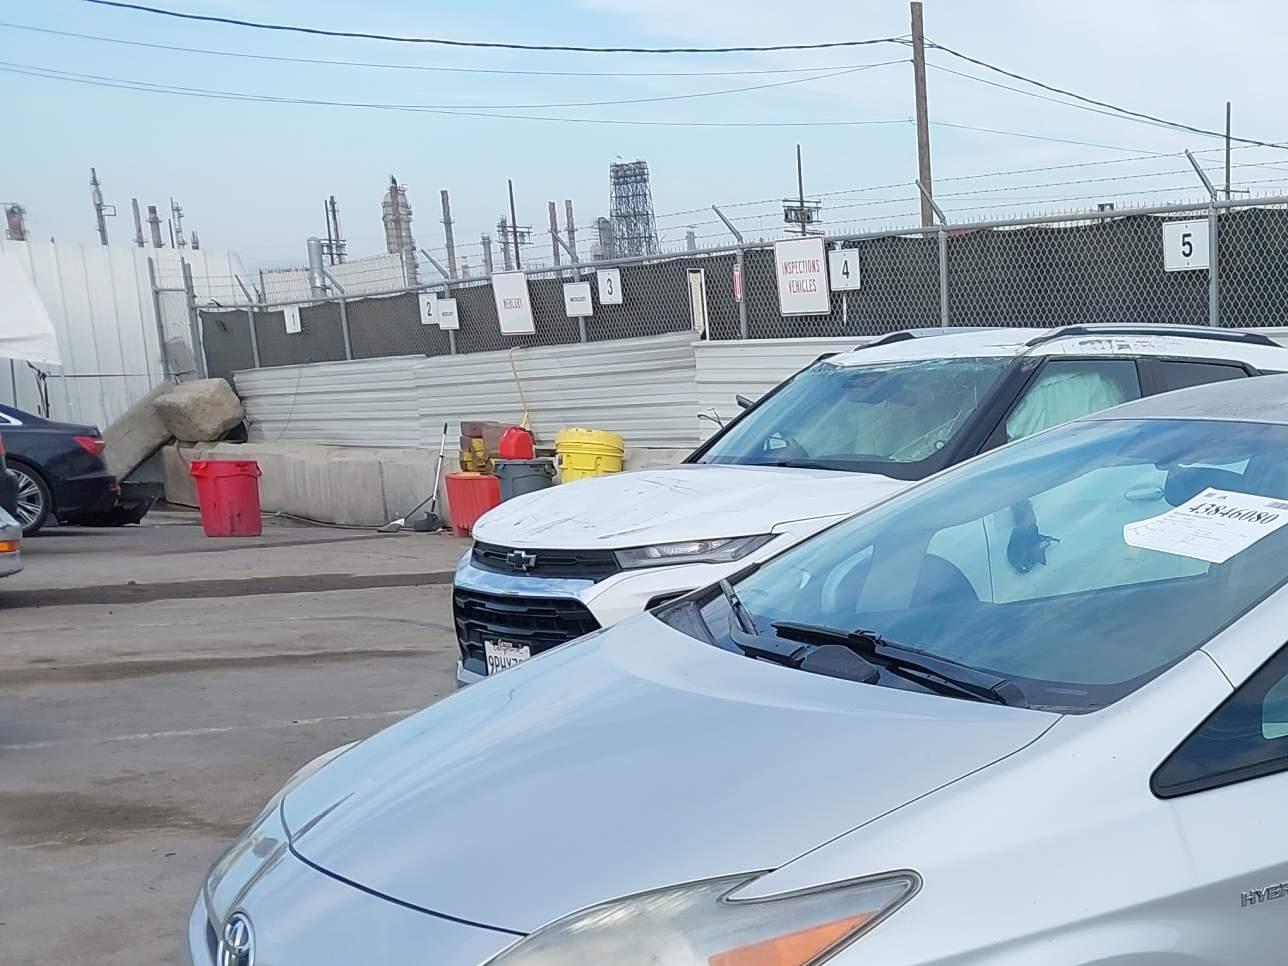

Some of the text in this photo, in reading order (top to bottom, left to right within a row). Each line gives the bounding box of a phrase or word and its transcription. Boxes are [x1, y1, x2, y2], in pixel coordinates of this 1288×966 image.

[1182, 233, 1193, 257] 5
[781, 259, 820, 276] INSPECTIONS
[842, 260, 850, 279] 4
[606, 278, 614, 296] 3
[788, 278, 817, 294] VEHICLES
[426, 301, 433, 317] 2
[291, 313, 296, 327] 1
[1187, 502, 1281, 525] 43846080
